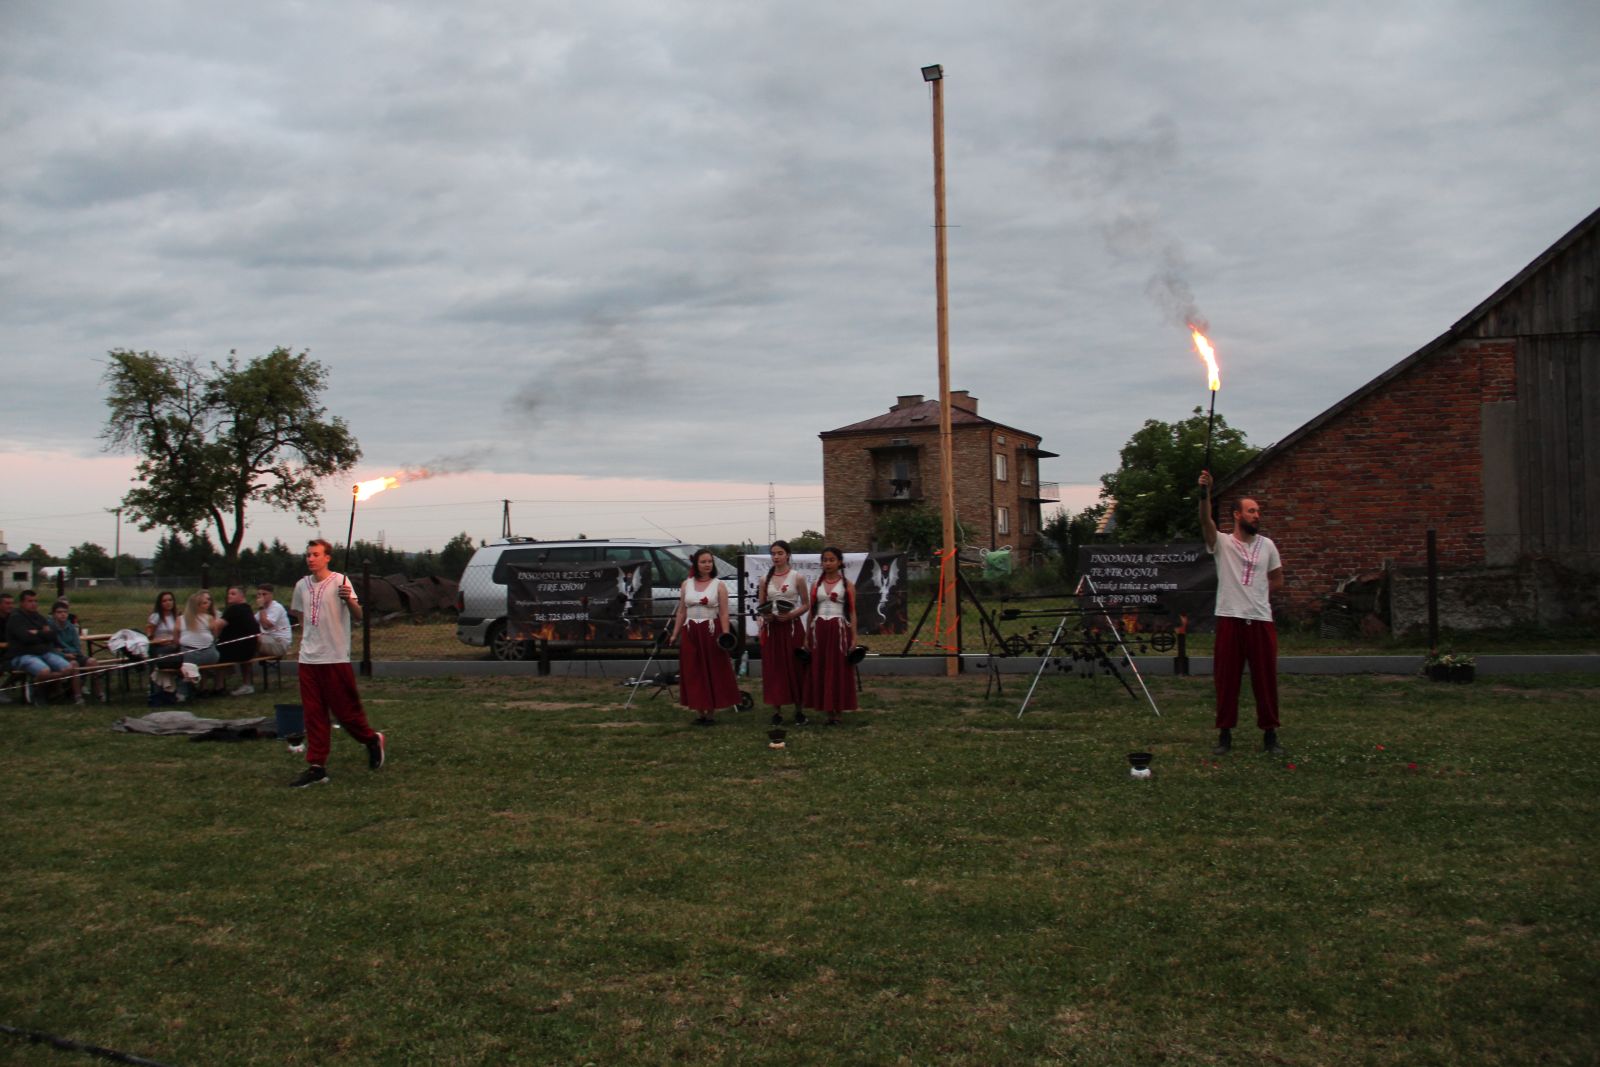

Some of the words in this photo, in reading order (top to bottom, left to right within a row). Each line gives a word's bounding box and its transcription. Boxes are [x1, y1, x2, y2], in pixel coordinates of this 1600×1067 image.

[1090, 568, 1123, 577] TEATR
[1124, 568, 1158, 579] OGNIA
[536, 583, 558, 592] FIRE
[559, 582, 586, 592] SHOW
[1109, 594, 1123, 603] 789
[1125, 594, 1140, 603] 670
[1142, 594, 1158, 603] 905
